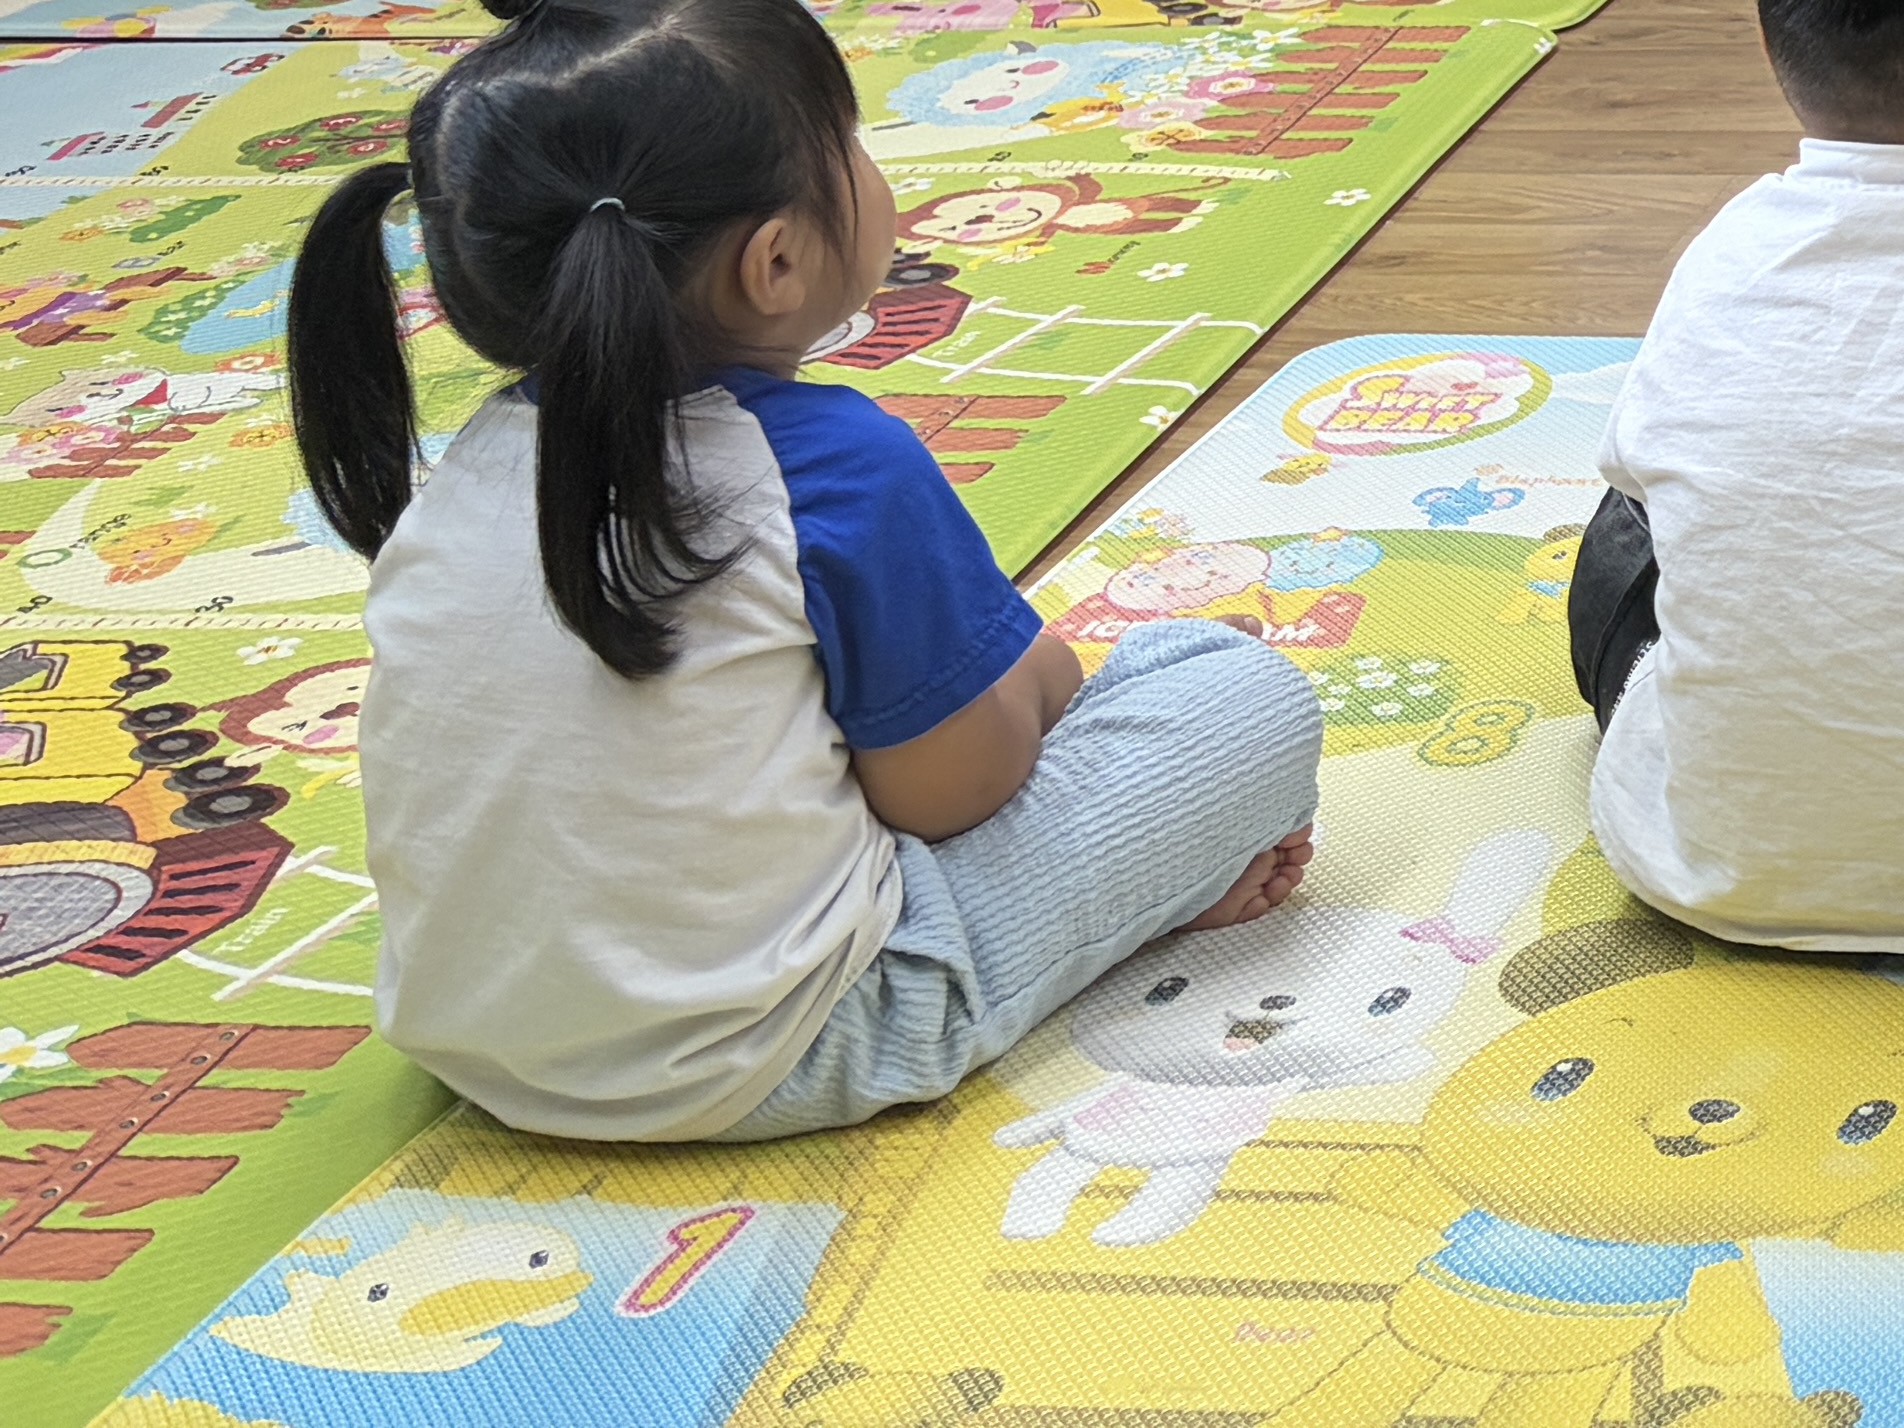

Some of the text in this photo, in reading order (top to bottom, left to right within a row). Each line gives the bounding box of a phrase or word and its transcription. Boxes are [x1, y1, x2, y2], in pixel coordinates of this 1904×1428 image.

[1345, 373, 1504, 411] SWEET
[1317, 408, 1483, 435] BEAR
[1416, 698, 1537, 767] 8
[212, 907, 289, 956] Train
[614, 1204, 757, 1316] 1
